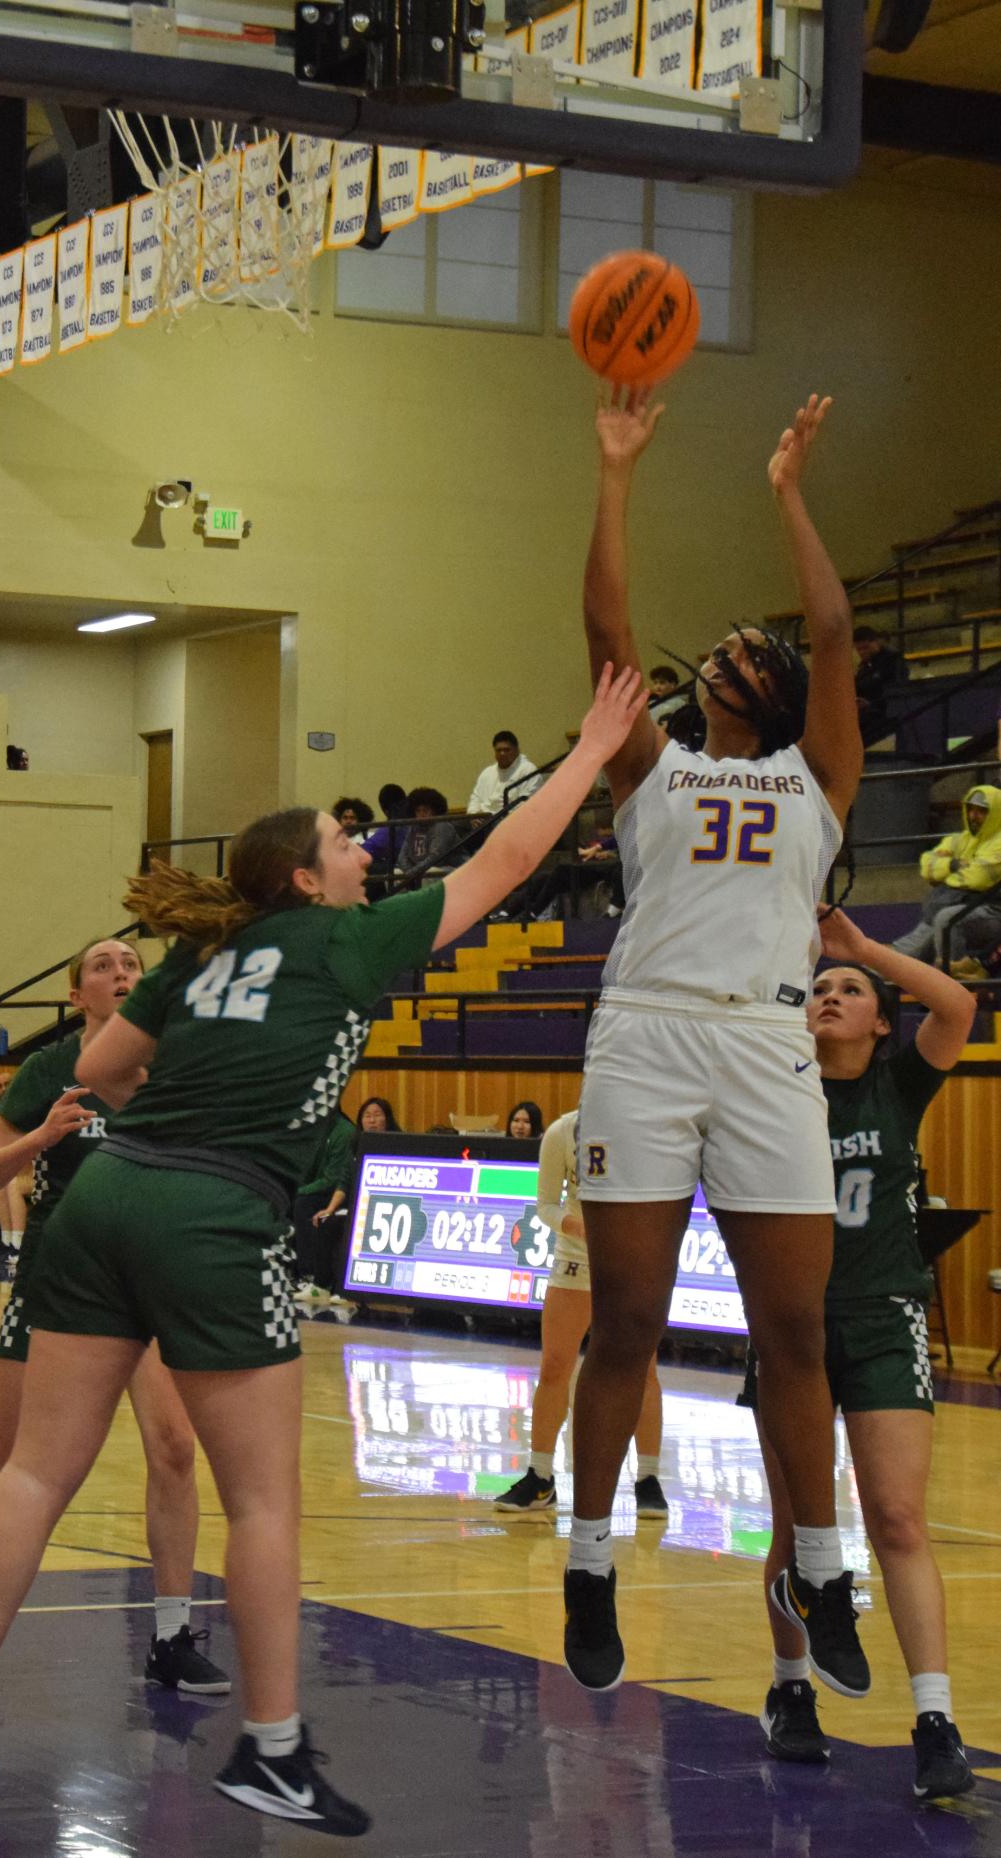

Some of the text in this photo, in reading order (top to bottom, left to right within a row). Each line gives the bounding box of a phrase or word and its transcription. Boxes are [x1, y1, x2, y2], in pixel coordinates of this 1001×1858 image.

[388, 161, 408, 180] 2001
[213, 510, 239, 531] EXIT
[667, 770, 805, 796] CRUSADERS
[690, 797, 778, 866] 32
[185, 947, 283, 1023] 42
[587, 1145, 606, 1176] R
[830, 1130, 883, 1160] ISH
[366, 1165, 439, 1189] CRUSADERS
[369, 1202, 412, 1254] 50
[432, 1210, 505, 1254] 02:12
[525, 1215, 555, 1267] 3
